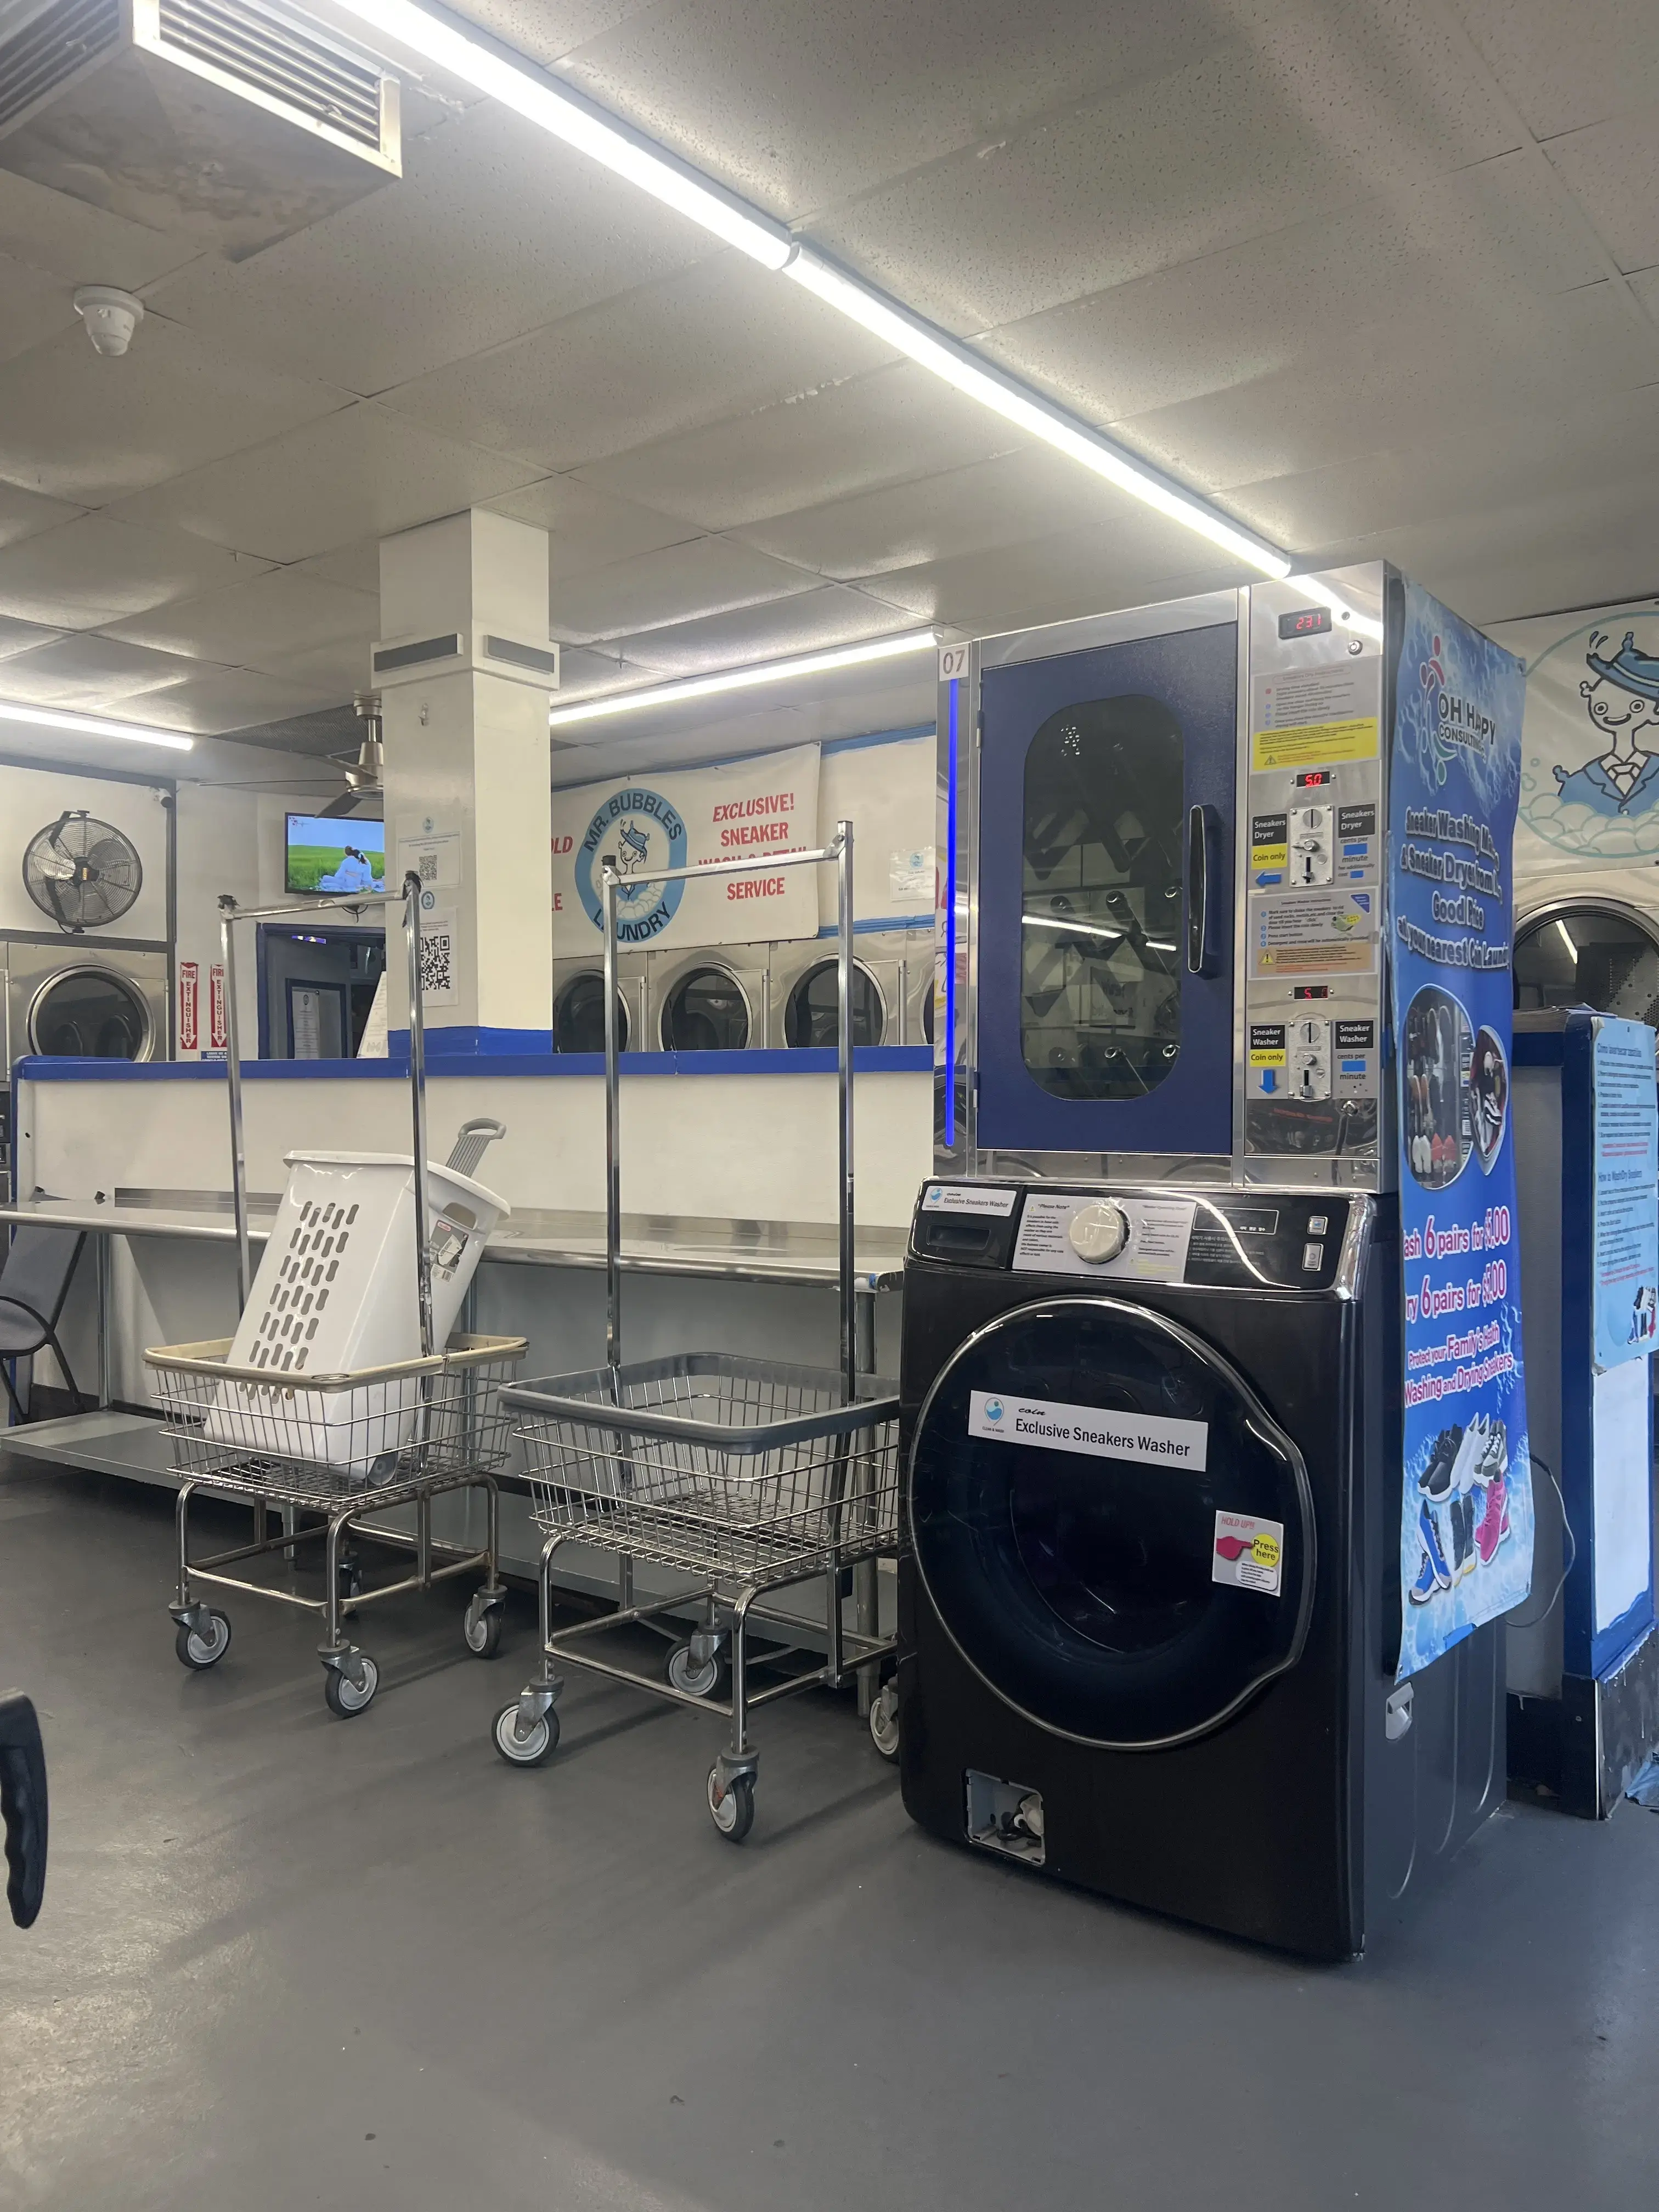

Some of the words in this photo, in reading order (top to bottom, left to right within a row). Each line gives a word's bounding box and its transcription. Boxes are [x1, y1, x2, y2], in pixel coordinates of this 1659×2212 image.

[943, 650, 965, 674] 07
[1438, 692, 1462, 723] OH
[713, 793, 794, 822] EXCLUSIVE!
[1341, 810, 1375, 820] Sneakers
[584, 815, 609, 851] MR.
[609, 793, 681, 840] BUBBLES
[1254, 819, 1286, 828] Sneakers
[1341, 821, 1362, 831] Dryer
[1406, 806, 1437, 837] Sneaker
[1437, 809, 1480, 855] Washing
[721, 822, 788, 847] SNEAKER
[1254, 831, 1274, 840] Dryer
[1270, 853, 1285, 861] only
[727, 877, 785, 900] SERVICE
[1432, 890, 1466, 924] Good
[592, 901, 670, 941] LUNDRY
[1425, 933, 1468, 966] nearest
[182, 970, 195, 979] FIRE
[1267, 1053, 1284, 1062] only
[1403, 1228, 1422, 1260] ash
[1424, 1214, 1436, 1258] 6
[1436, 1224, 1470, 1259] pairs
[1471, 1221, 1483, 1251] for
[1406, 1293, 1419, 1324] ry
[1420, 1274, 1432, 1318] 6
[1432, 1282, 1465, 1319] pairs
[1466, 1278, 1481, 1309] for
[1408, 1347, 1430, 1370] Protect
[1430, 1345, 1447, 1366] your
[1446, 1326, 1483, 1361] Family's
[1404, 1373, 1443, 1408] Washing
[1443, 1373, 1457, 1395] and
[1457, 1361, 1483, 1392] Drying
[1018, 1407, 1046, 1415] coin
[1016, 1418, 1069, 1438] Exclusive
[1073, 1426, 1134, 1449] Sneakers
[1137, 1436, 1190, 1457] Washer
[1221, 1516, 1240, 1526] HOLD
[1253, 1539, 1279, 1553] Press
[1256, 1549, 1276, 1561] here
